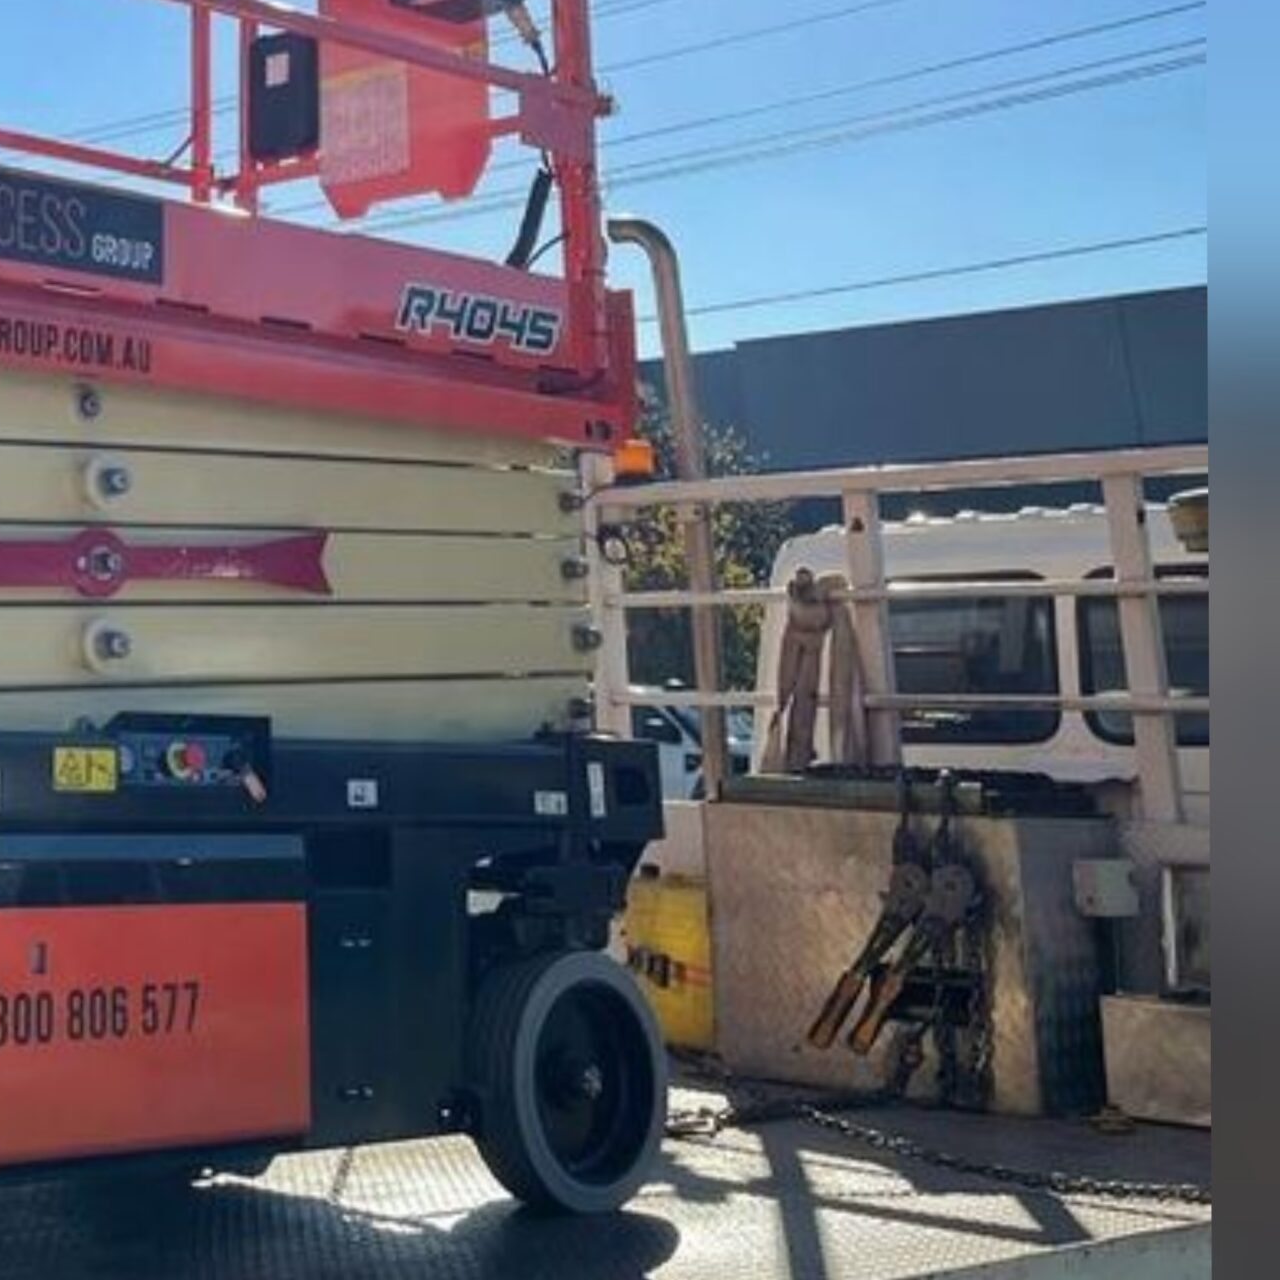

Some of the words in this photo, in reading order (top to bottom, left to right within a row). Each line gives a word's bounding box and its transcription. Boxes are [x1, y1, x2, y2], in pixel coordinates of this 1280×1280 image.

[91, 233, 154, 270] GROUP
[66, 985, 128, 1040] 806
[141, 981, 199, 1035] 577
